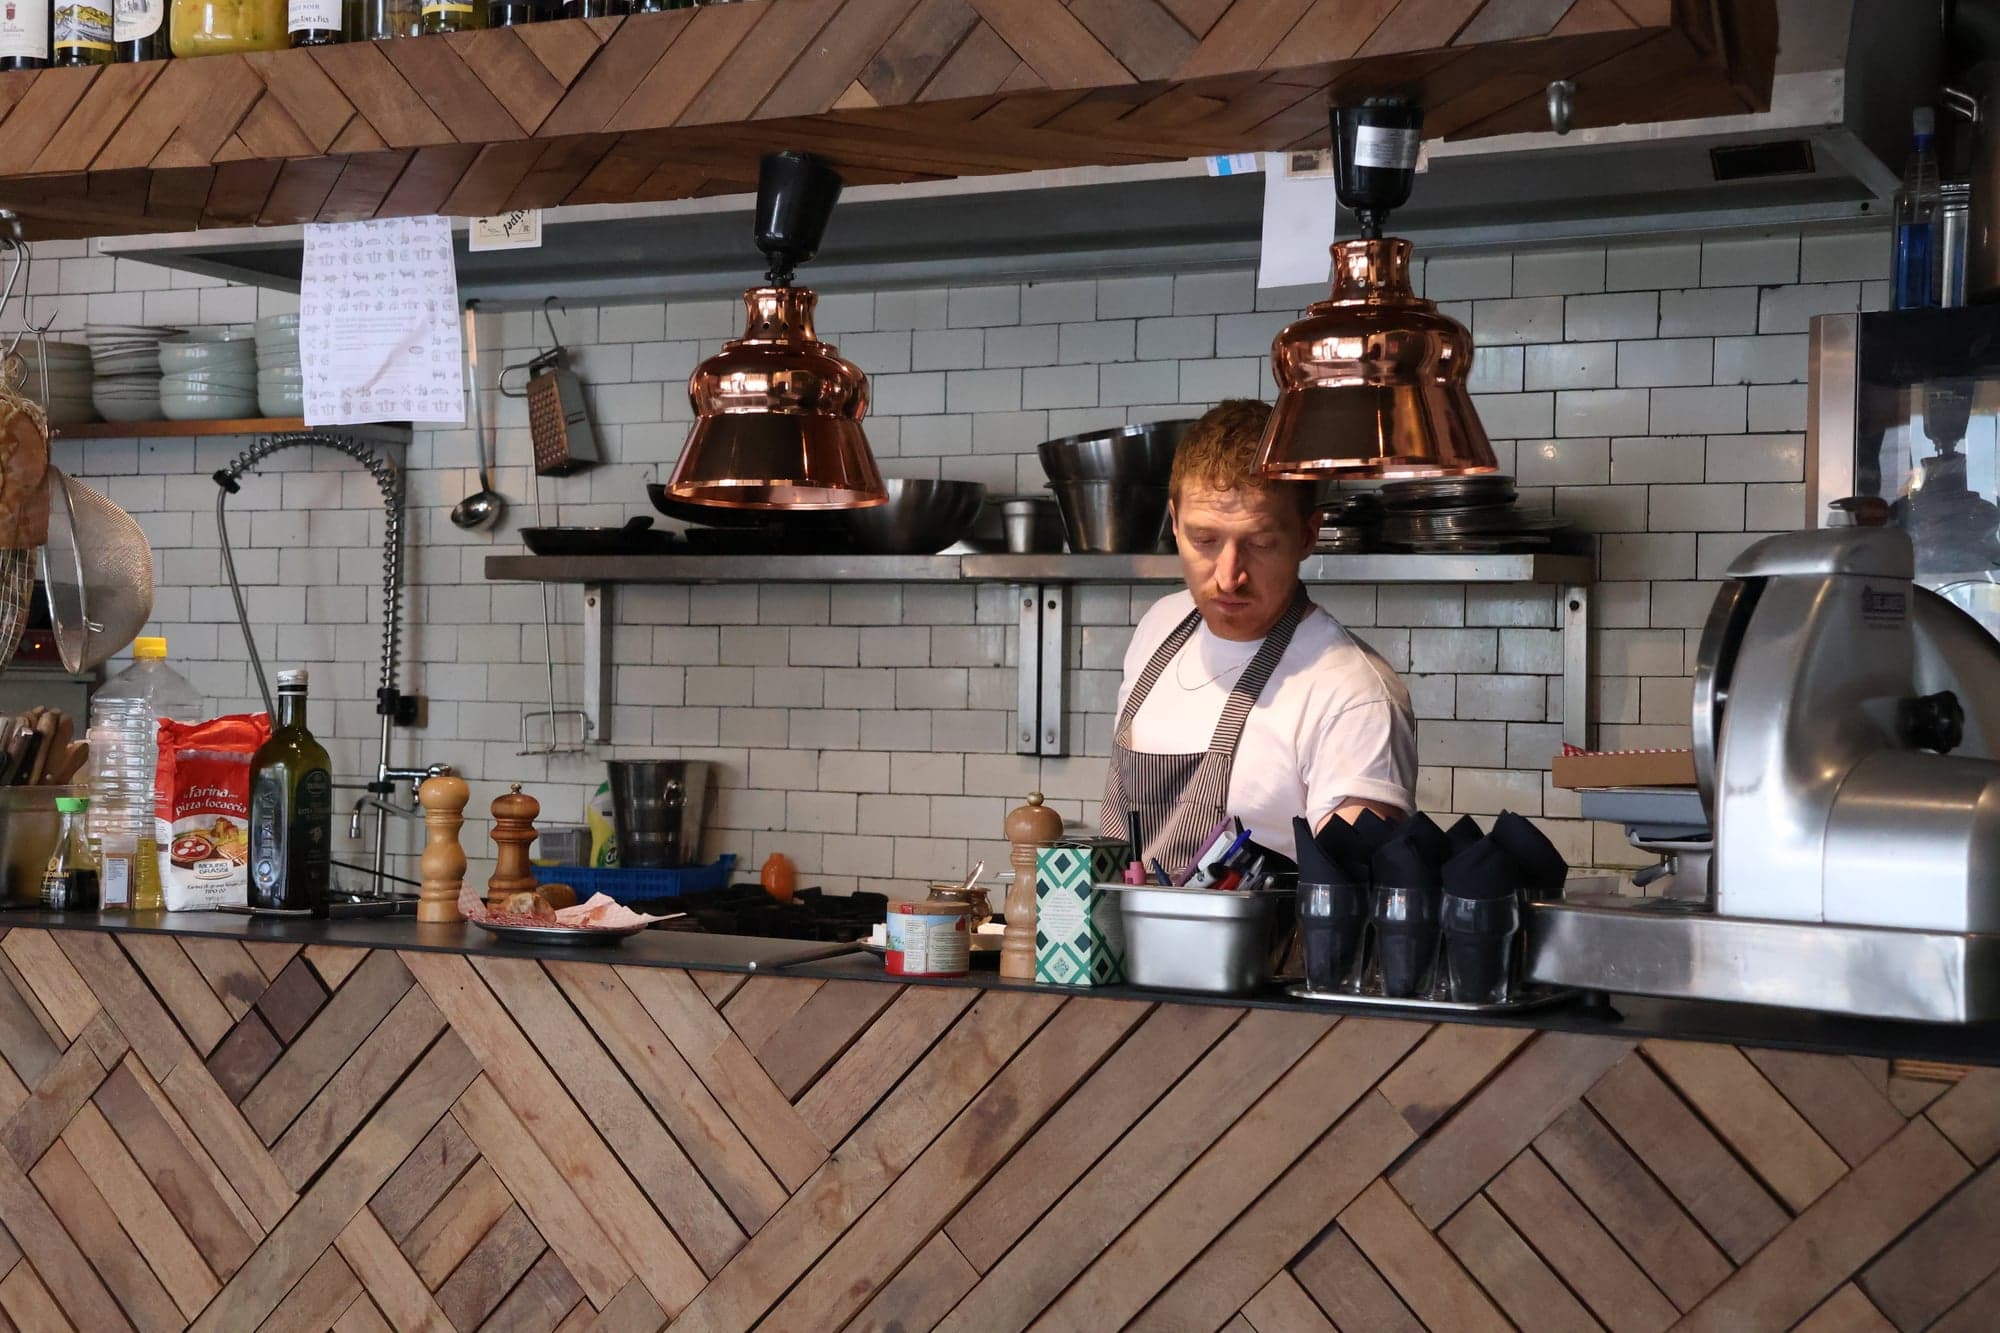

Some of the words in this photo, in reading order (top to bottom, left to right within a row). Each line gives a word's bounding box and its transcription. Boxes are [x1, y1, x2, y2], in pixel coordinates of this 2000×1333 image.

[189, 784, 230, 799] Farina
[175, 802, 201, 817] pizza
[205, 798, 247, 814] focaccia
